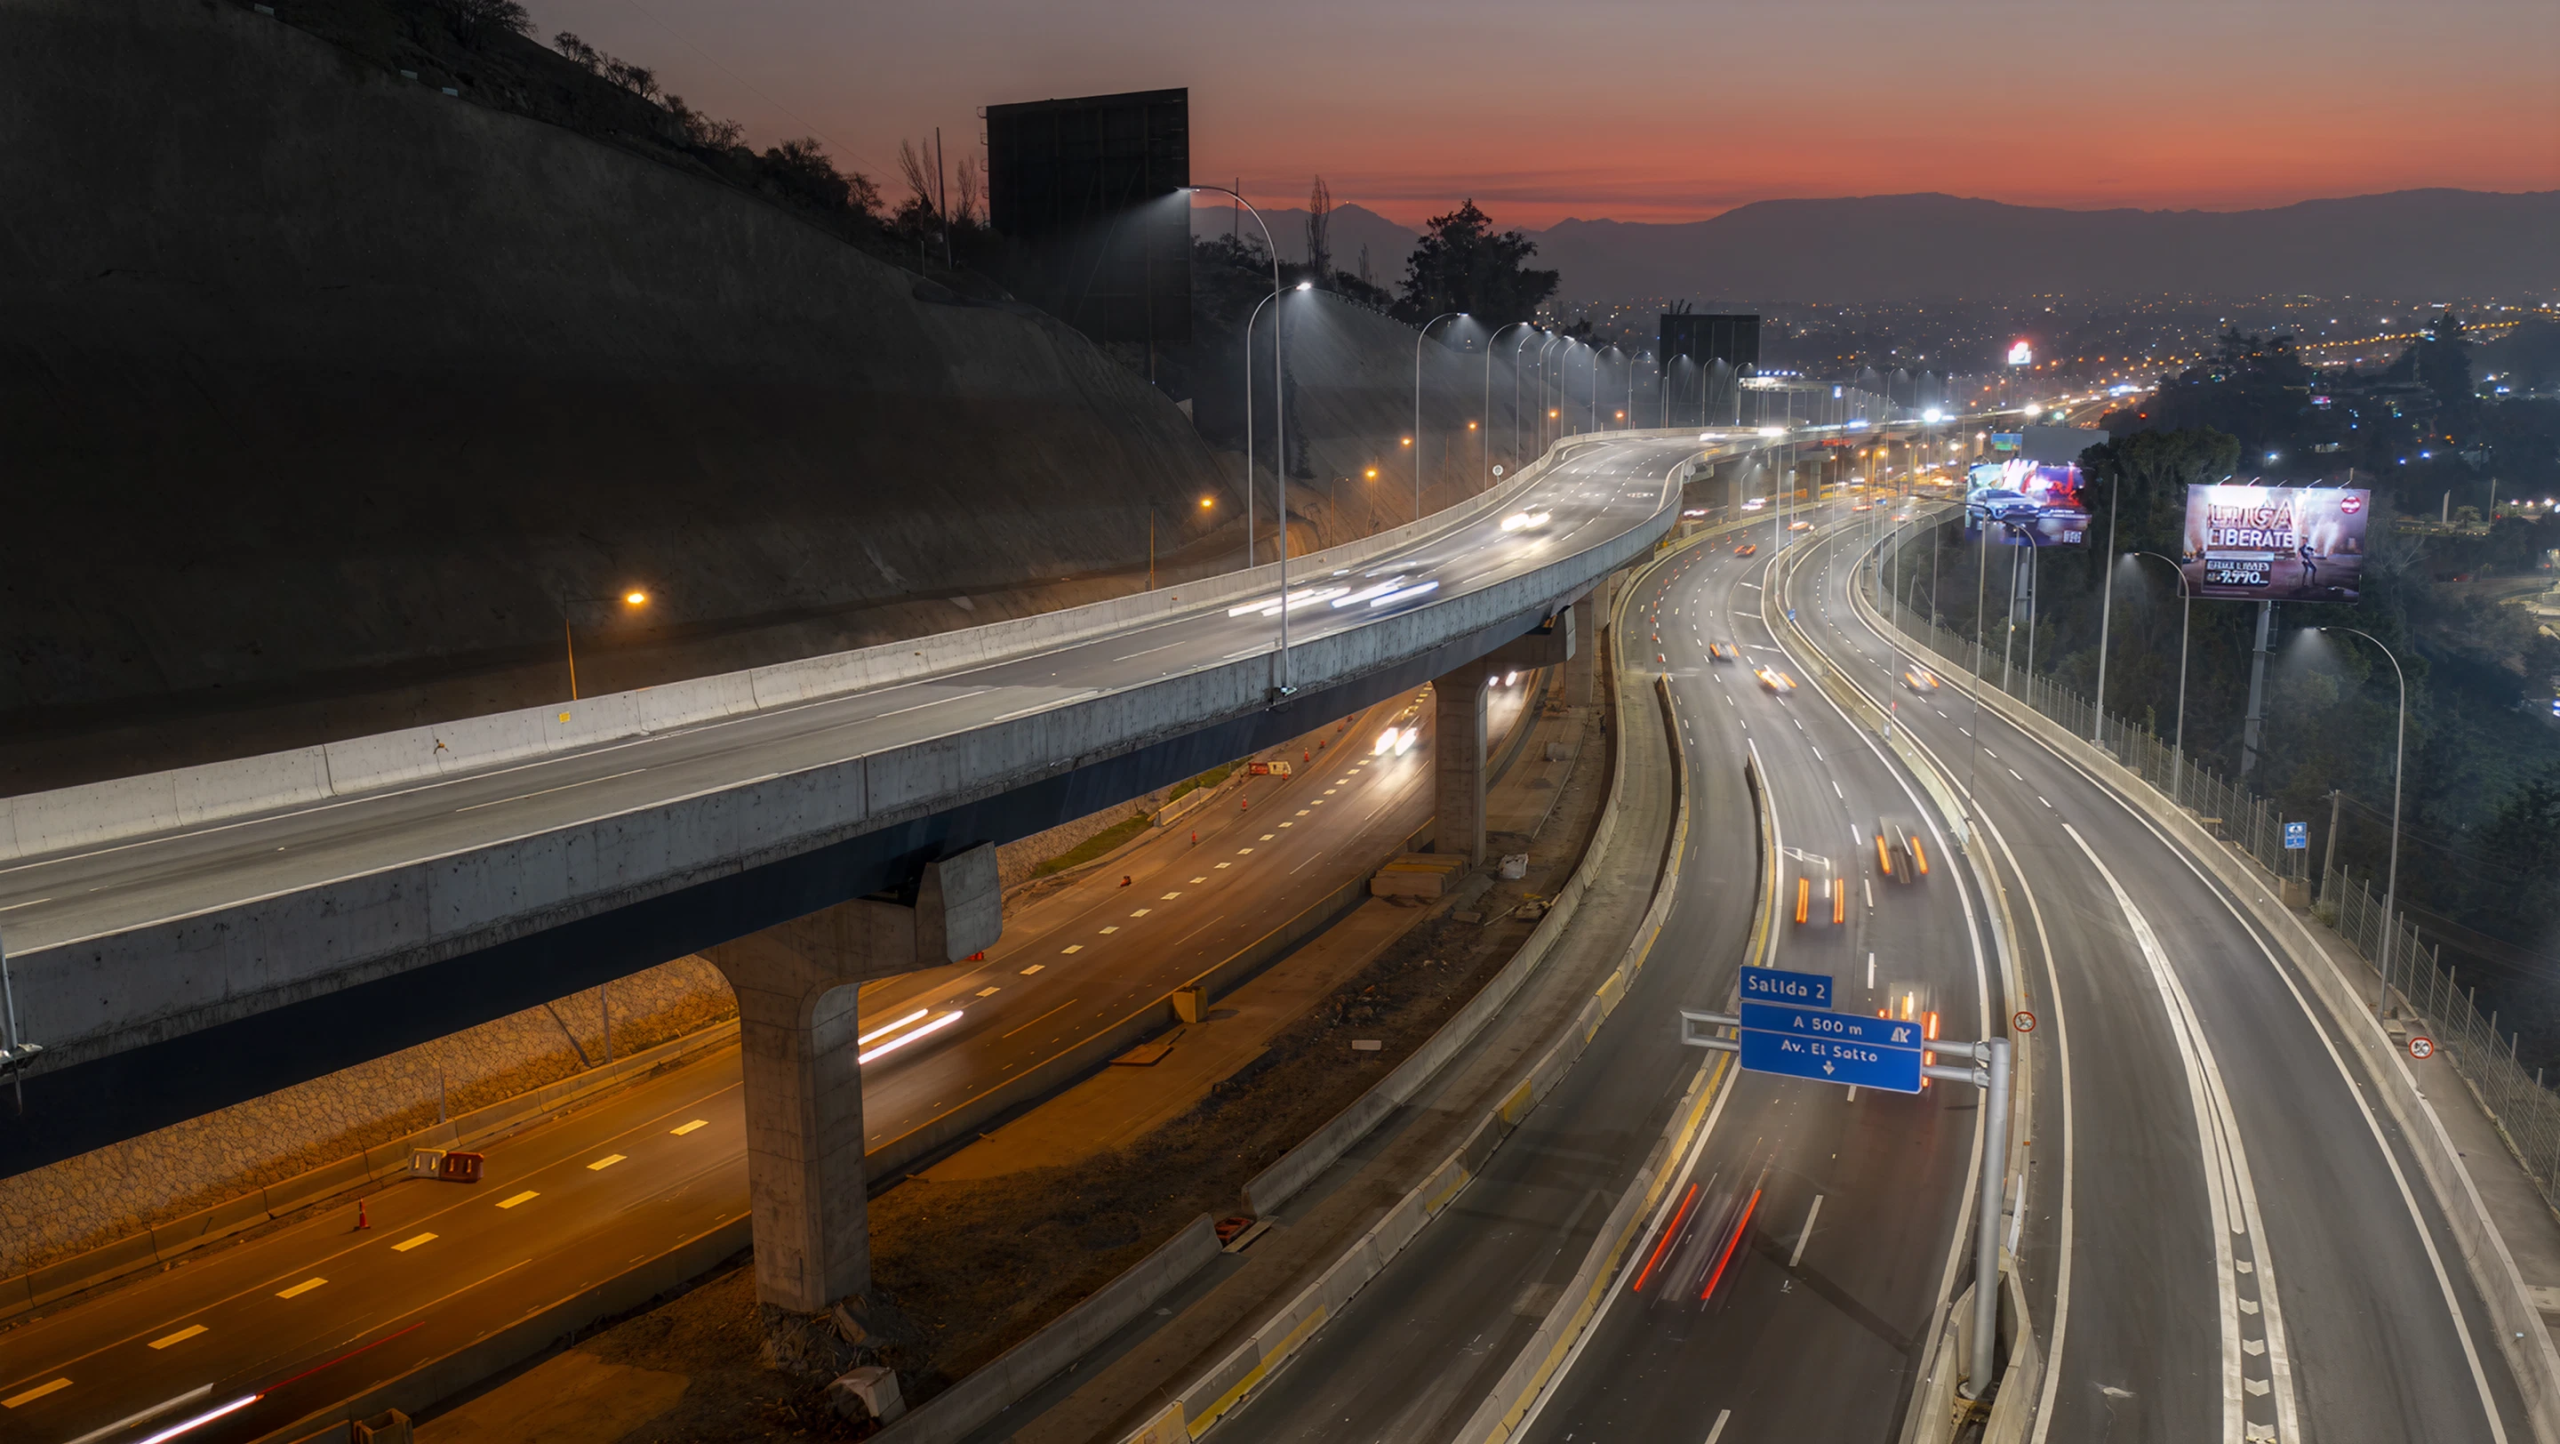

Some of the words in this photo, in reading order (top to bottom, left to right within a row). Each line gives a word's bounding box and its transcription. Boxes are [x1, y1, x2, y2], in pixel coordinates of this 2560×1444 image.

[1748, 975, 1807, 997] Salida
[1815, 984, 1826, 1000] 2
[1793, 1016, 1804, 1028] A
[1812, 1018, 1843, 1033] 500
[1849, 1024, 1862, 1035] m
[1781, 1039, 1805, 1054] Av.
[1812, 1043, 1826, 1056] El
[1833, 1045, 1878, 1062] Salto
